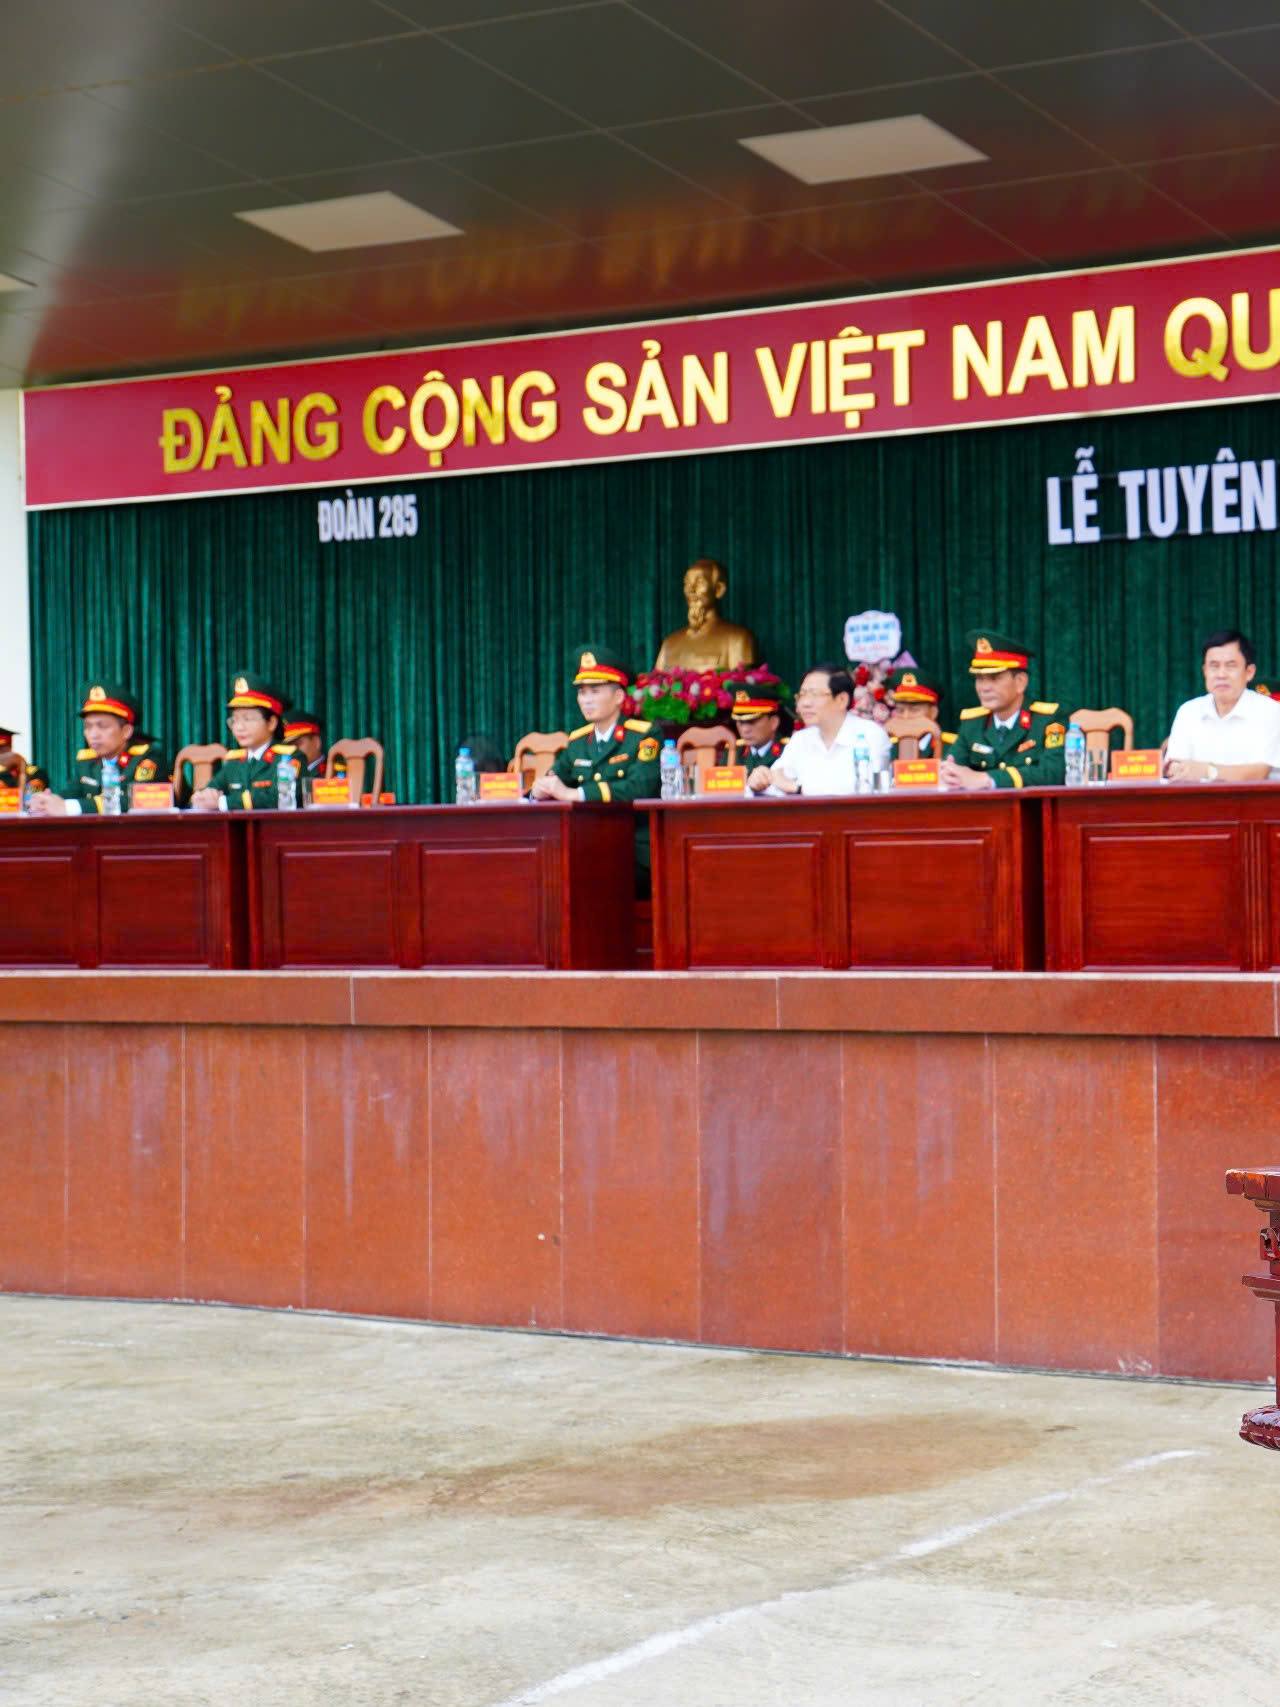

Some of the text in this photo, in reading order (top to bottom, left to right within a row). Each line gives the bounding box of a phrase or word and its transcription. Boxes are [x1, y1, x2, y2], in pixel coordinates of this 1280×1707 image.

[159, 386, 339, 473] ĐẢNG
[363, 370, 558, 468] CỘNG
[582, 339, 730, 436] SẢN
[754, 326, 926, 429] VIỆT
[952, 305, 1135, 401] NAM
[317, 488, 418, 542] ĐOÀN 285
[1046, 446, 1101, 545] LỄ
[1117, 447, 1277, 540] TUYÊN
